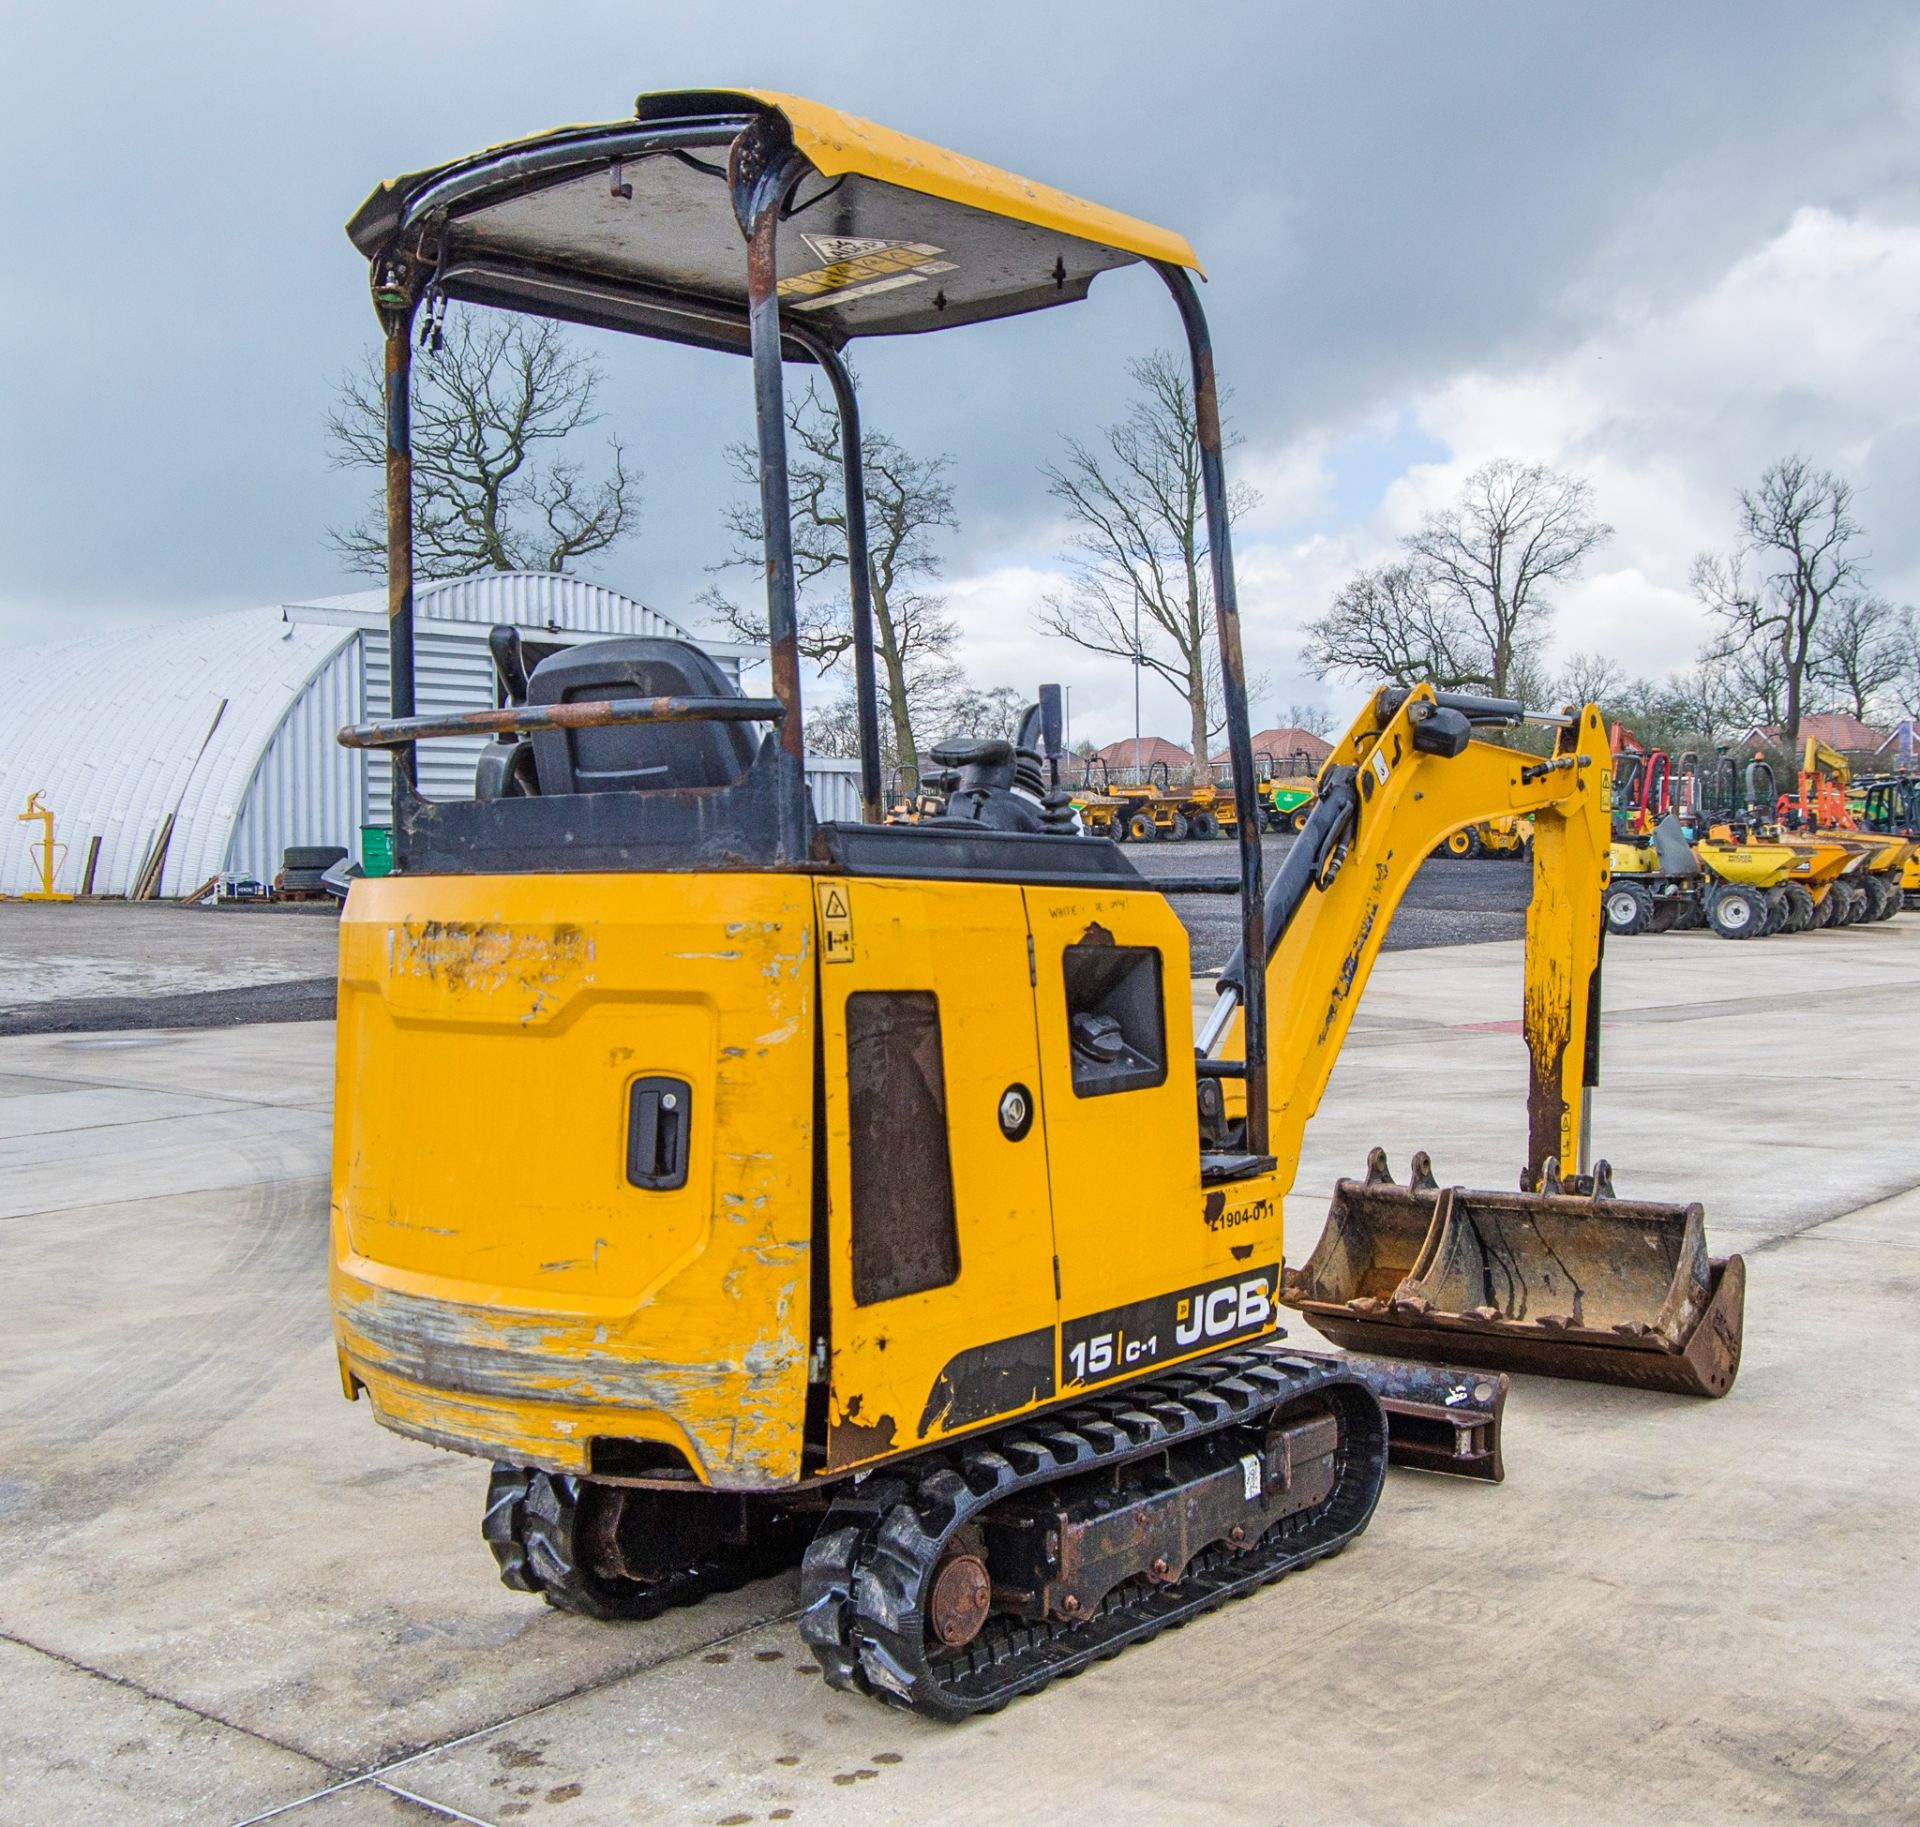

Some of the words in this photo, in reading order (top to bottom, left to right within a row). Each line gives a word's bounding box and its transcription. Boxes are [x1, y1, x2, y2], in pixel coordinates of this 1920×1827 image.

[1176, 1277, 1270, 1346] JCB
[1069, 1333, 1113, 1374] 15
[1125, 1335, 1157, 1362] C-1
